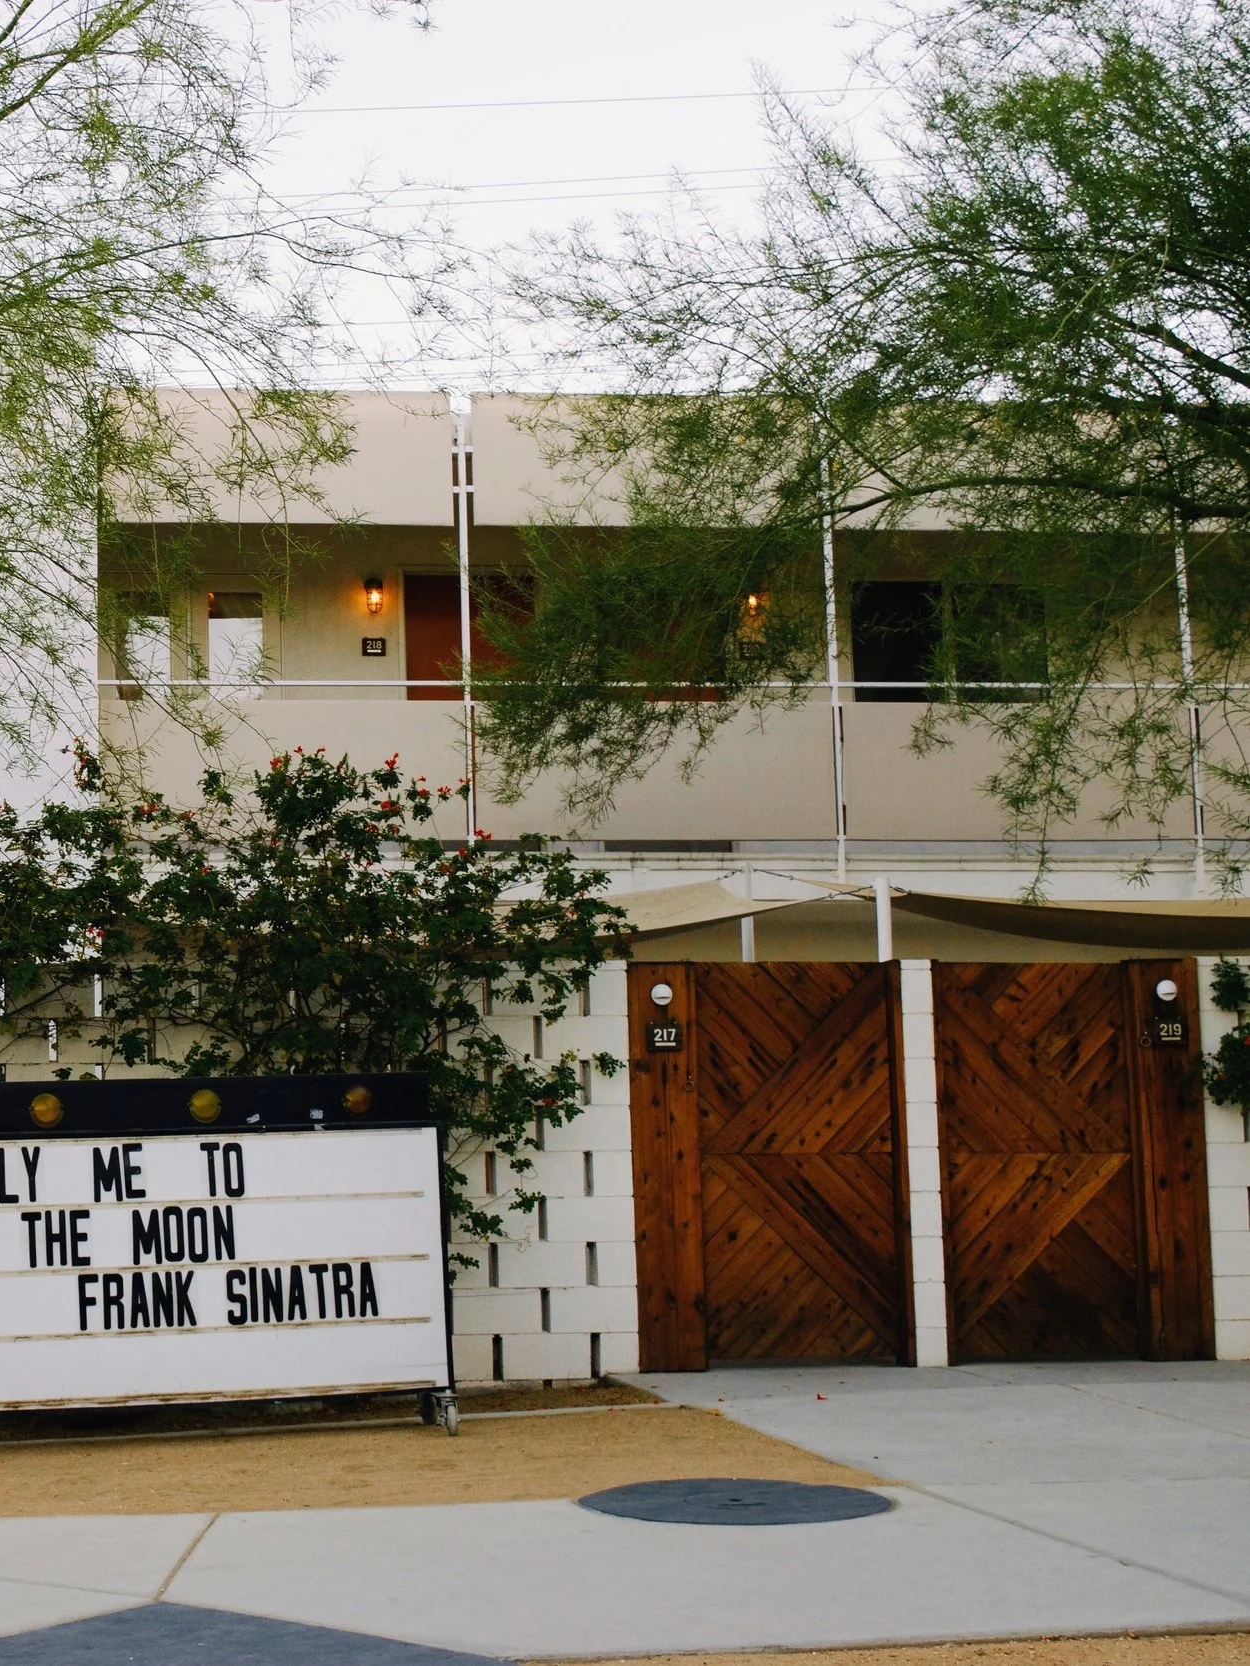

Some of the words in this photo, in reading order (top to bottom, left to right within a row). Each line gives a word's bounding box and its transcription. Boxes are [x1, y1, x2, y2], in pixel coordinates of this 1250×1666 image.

[366, 640, 382, 649] 218
[653, 1028, 676, 1041] 217
[1159, 1023, 1182, 1036] 219
[92, 1142, 147, 1203] ME
[199, 1141, 245, 1198] TO
[20, 1209, 91, 1269] THE
[131, 1204, 236, 1266] MOON
[77, 1270, 198, 1332] FRANK
[225, 1261, 380, 1327] SINATRA
